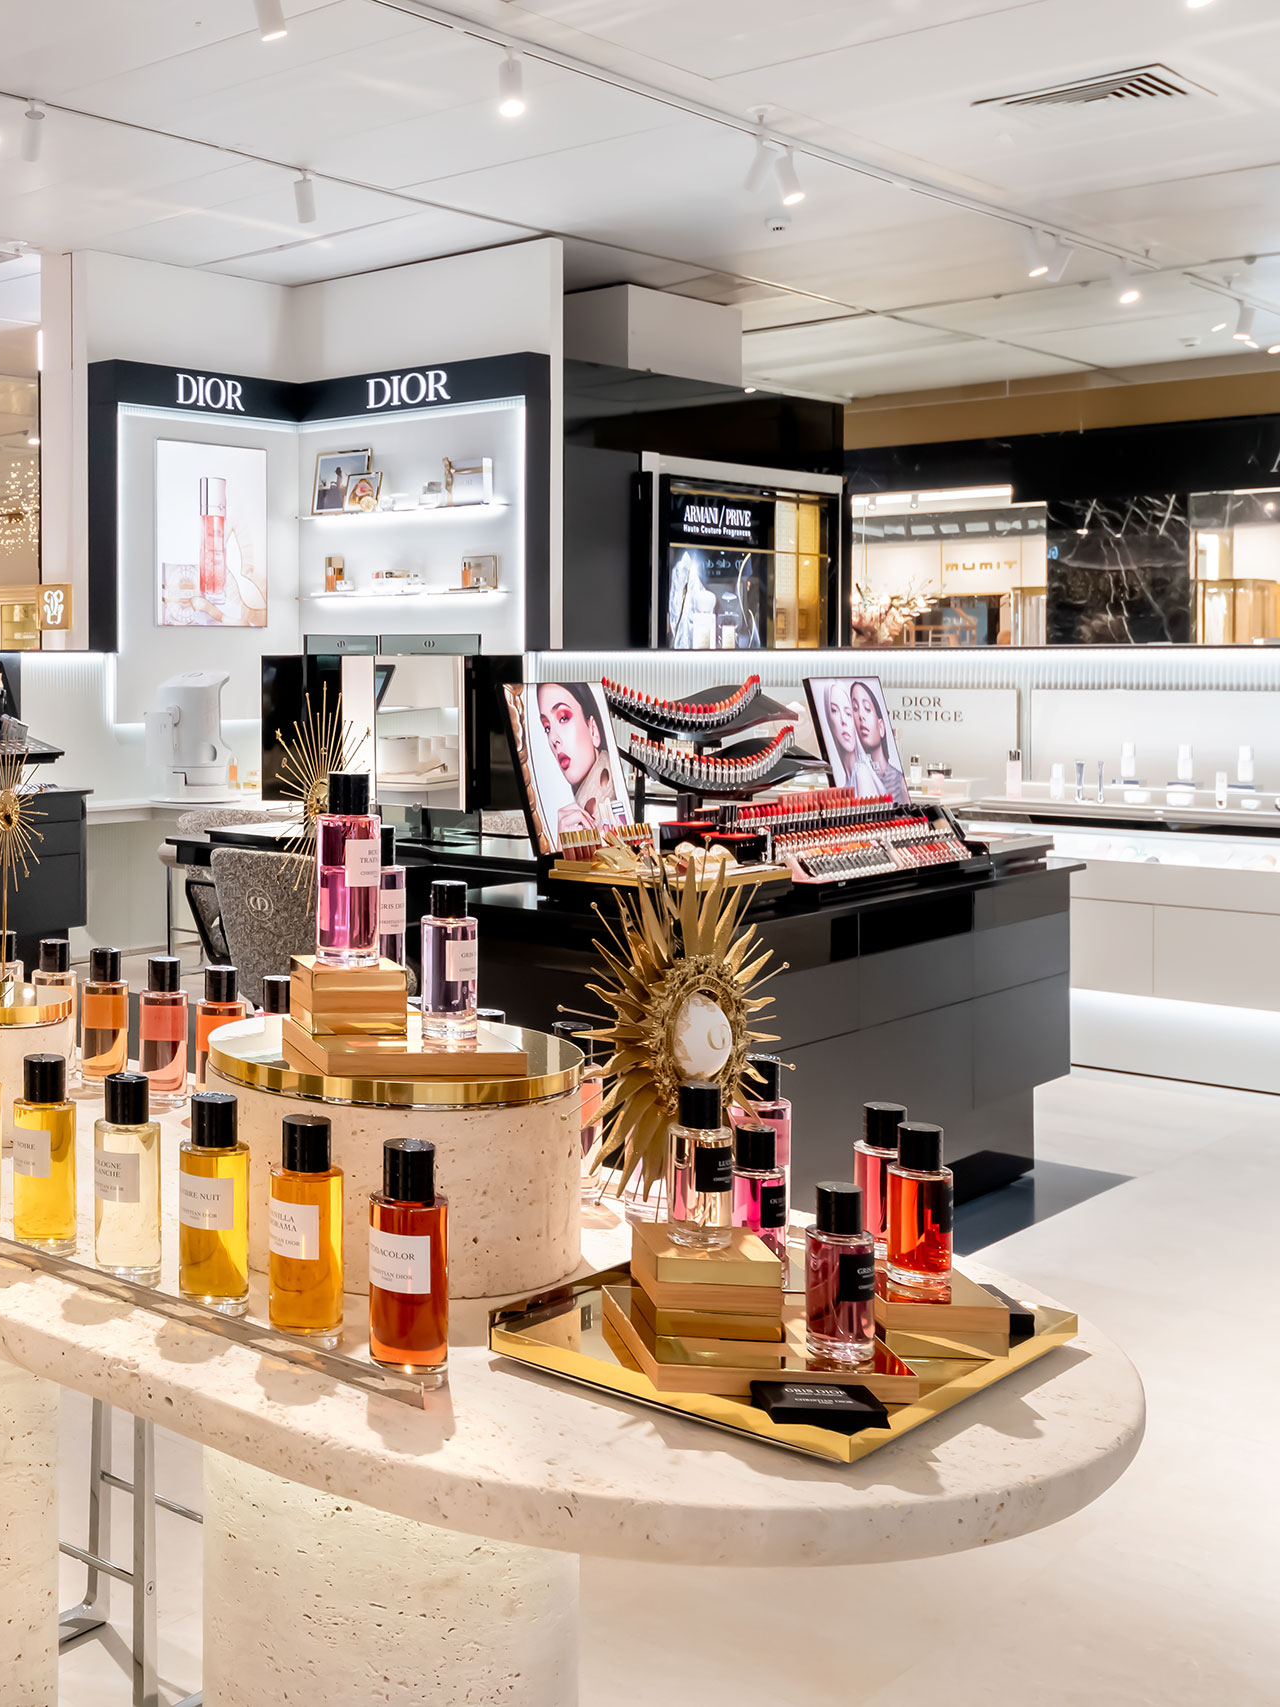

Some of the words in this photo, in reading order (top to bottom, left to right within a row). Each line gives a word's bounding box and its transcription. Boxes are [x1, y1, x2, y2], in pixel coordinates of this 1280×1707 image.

[176, 373, 245, 412] DIOR
[366, 370, 451, 409] DIOR
[902, 696, 942, 708] DIOR
[97, 1160, 121, 1170] LOGNE
[96, 1167, 121, 1178] LANCHE
[199, 1192, 221, 1201] NUIT
[271, 1210, 295, 1224] ANILLA
[815, 1388, 848, 1396] DIOR
